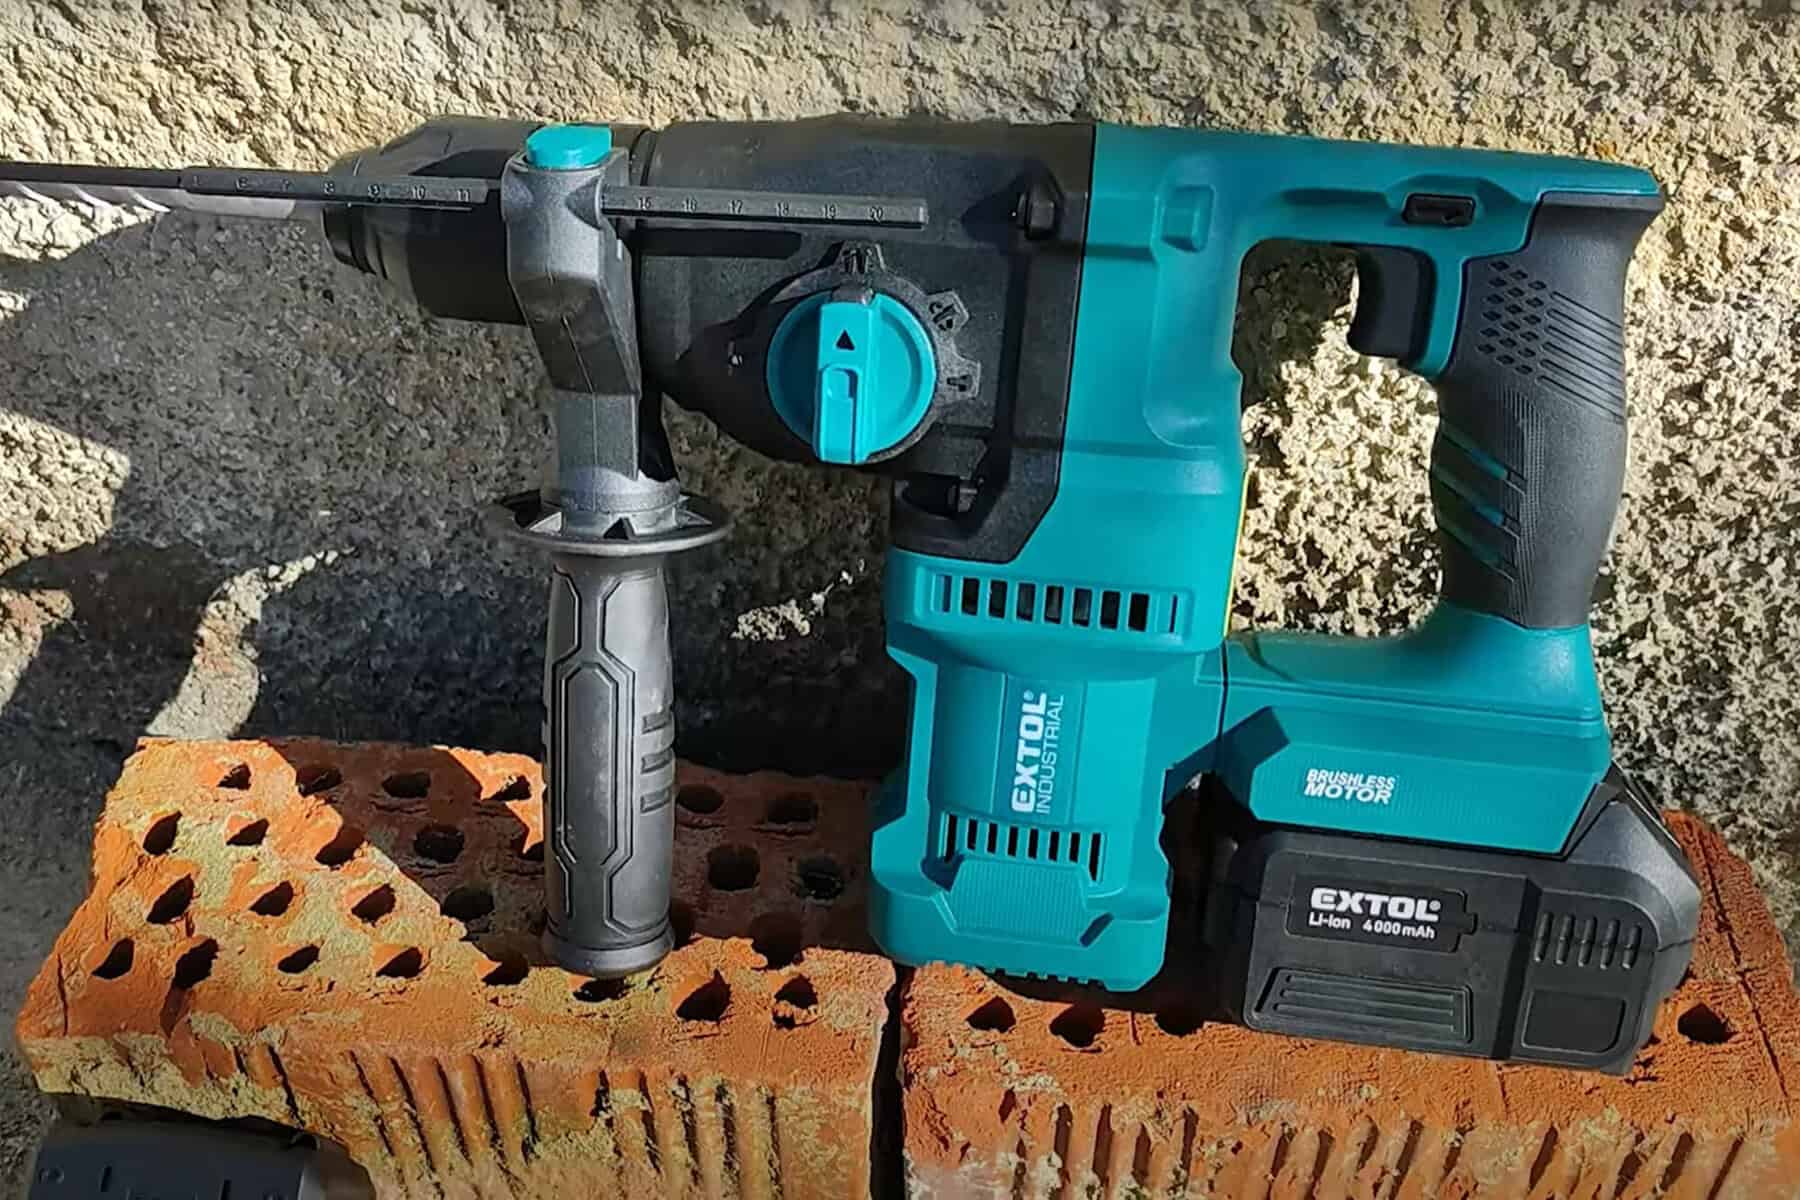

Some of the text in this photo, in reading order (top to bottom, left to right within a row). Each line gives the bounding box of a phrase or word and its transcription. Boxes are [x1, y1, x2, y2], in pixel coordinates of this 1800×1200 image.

[412, 185, 425, 200] 10
[457, 188, 470, 202] 11
[776, 202, 790, 217] 18
[823, 203, 838, 219] 19
[868, 205, 884, 222] 20
[1012, 691, 1047, 812] EXTOL
[1036, 695, 1064, 815] INDUSTRIAL
[1306, 768, 1396, 790] BRUSHLESS
[1304, 782, 1392, 804] MOTOR
[1311, 887, 1440, 922] EXTOL
